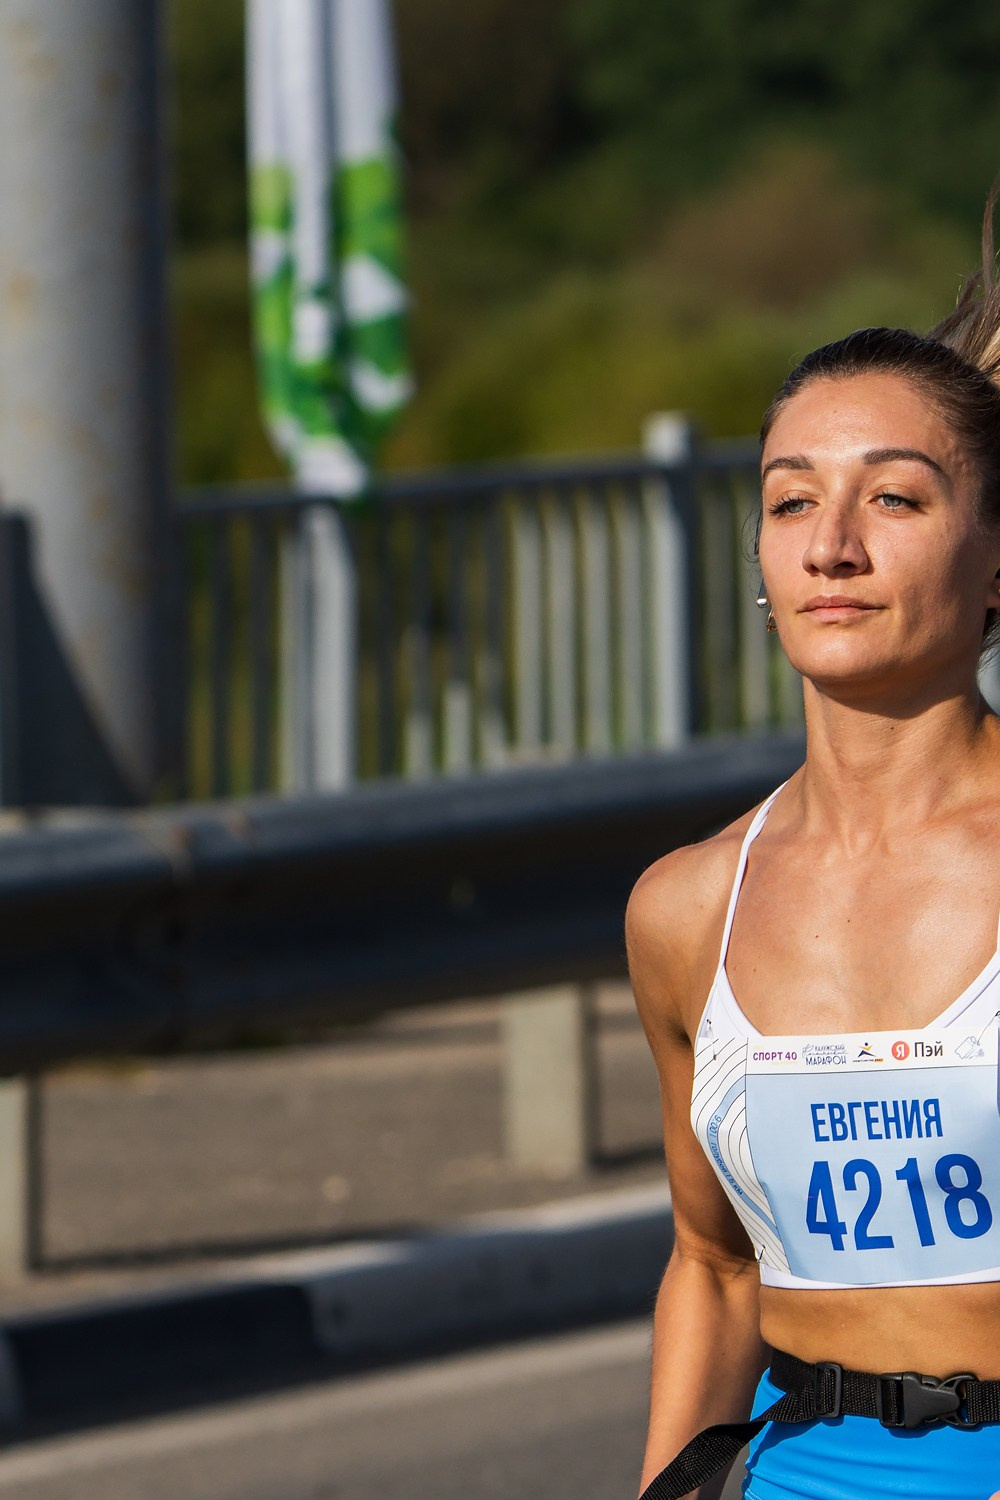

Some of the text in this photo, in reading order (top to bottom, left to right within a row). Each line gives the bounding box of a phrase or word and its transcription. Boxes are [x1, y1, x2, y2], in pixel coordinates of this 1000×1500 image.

[752, 1051, 783, 1061] СПОРТ
[785, 1051, 797, 1060] 40
[914, 1040, 943, 1058] Пэй
[805, 1055, 847, 1065] МАРАФОН
[709, 1114, 722, 1134] 9:00
[810, 1098, 944, 1142] ЕВГЕНИЯ
[805, 1153, 993, 1251] 4218
